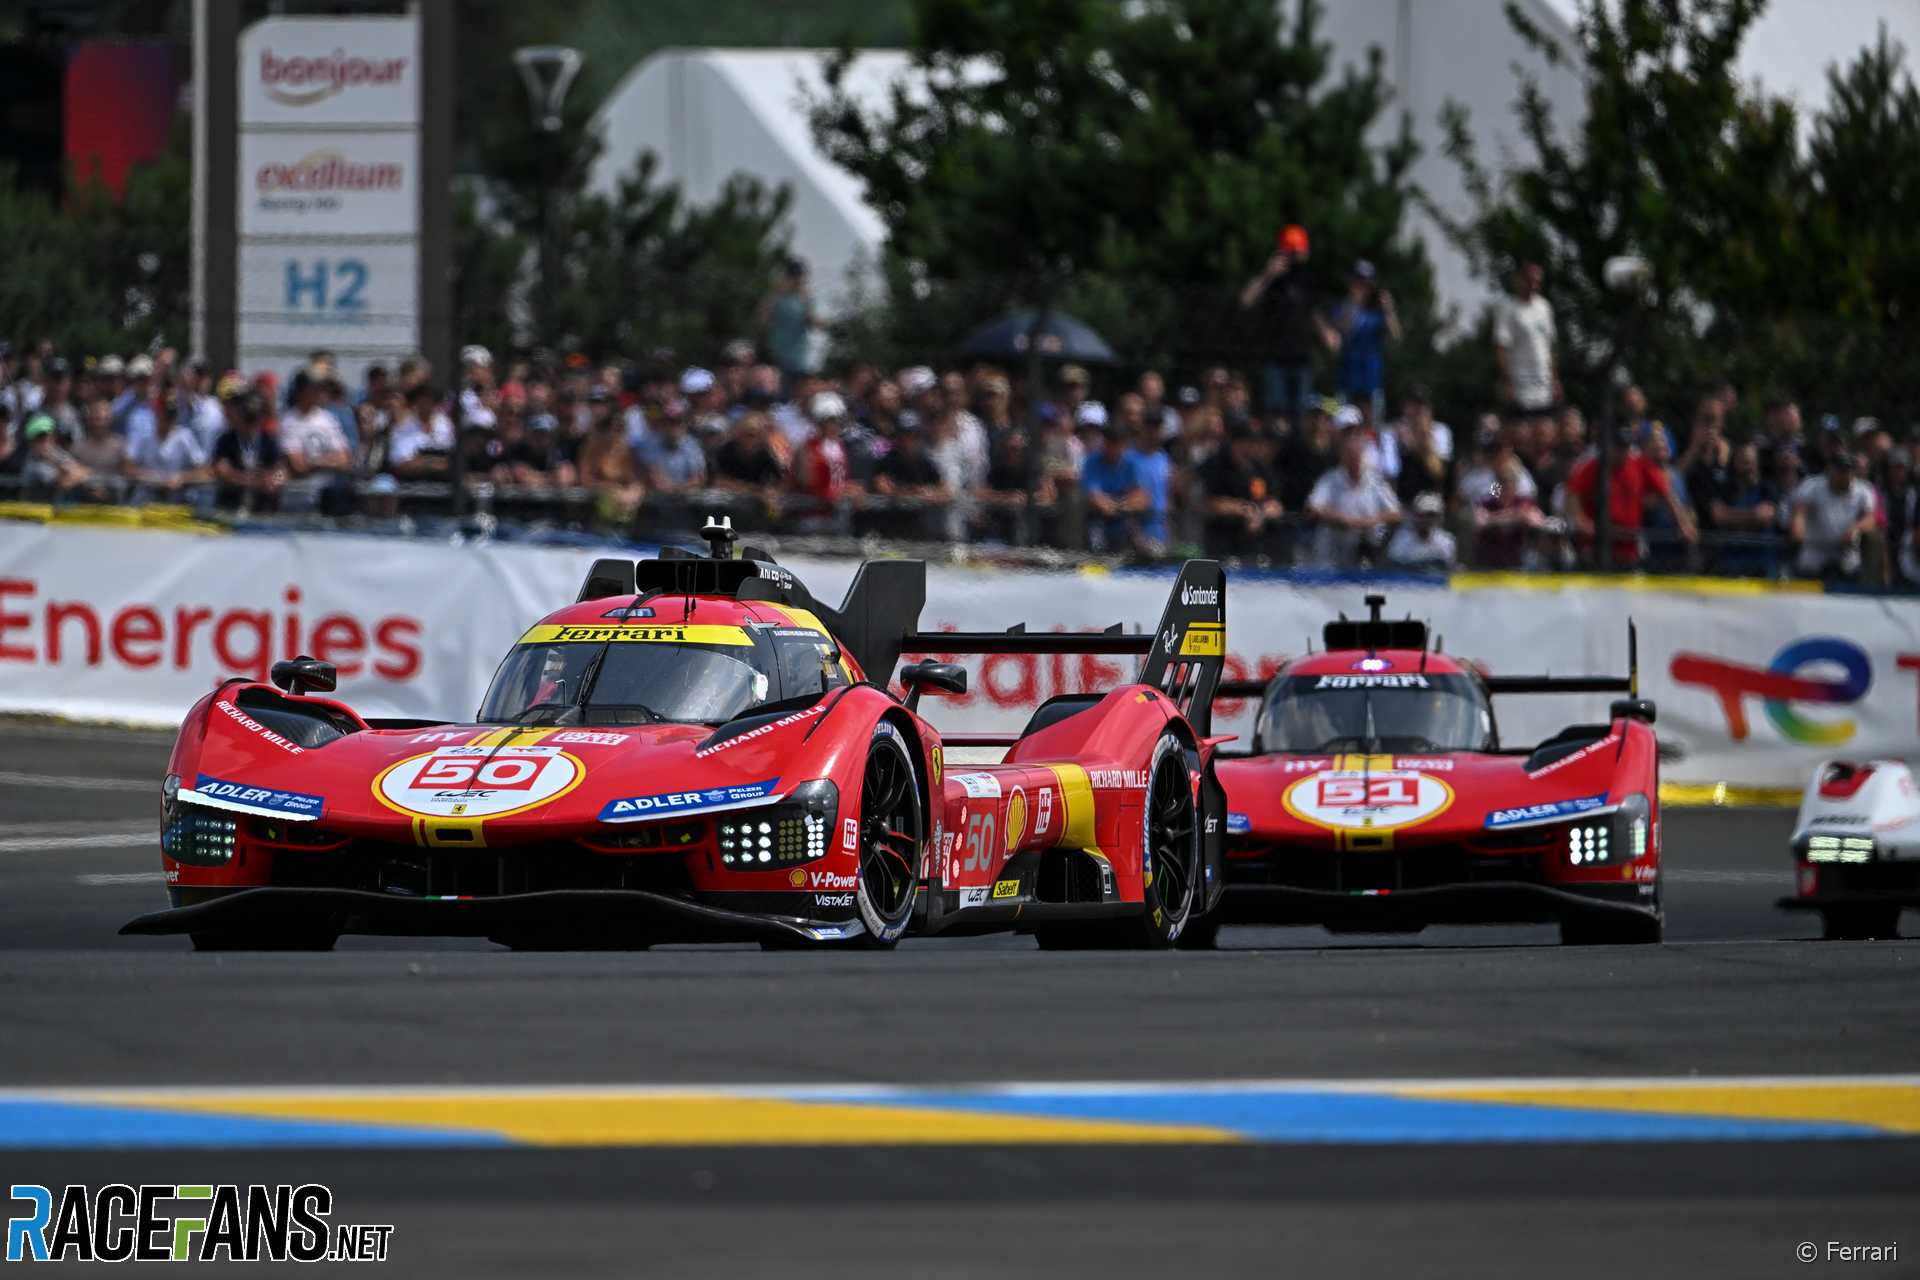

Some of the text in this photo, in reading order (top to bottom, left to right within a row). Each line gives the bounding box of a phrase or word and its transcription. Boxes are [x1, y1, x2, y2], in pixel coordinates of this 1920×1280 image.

[261, 47, 408, 92] bonjour
[286, 258, 370, 308] H2
[1189, 585, 1219, 606] Santander
[550, 625, 689, 641] Ferrari
[1315, 674, 1430, 689] Ferrari
[216, 700, 305, 755] RICHARD MILLE
[696, 705, 828, 759] RICHARD MILLE
[419, 759, 537, 785] 50
[1091, 770, 1148, 788] RICHARD MILLE
[196, 782, 272, 803] ADLER
[1323, 778, 1415, 804] 51
[613, 792, 703, 812] ADLER
[1493, 803, 1559, 824] ADLER
[963, 813, 996, 872] 50
[811, 871, 857, 887] V-Power
